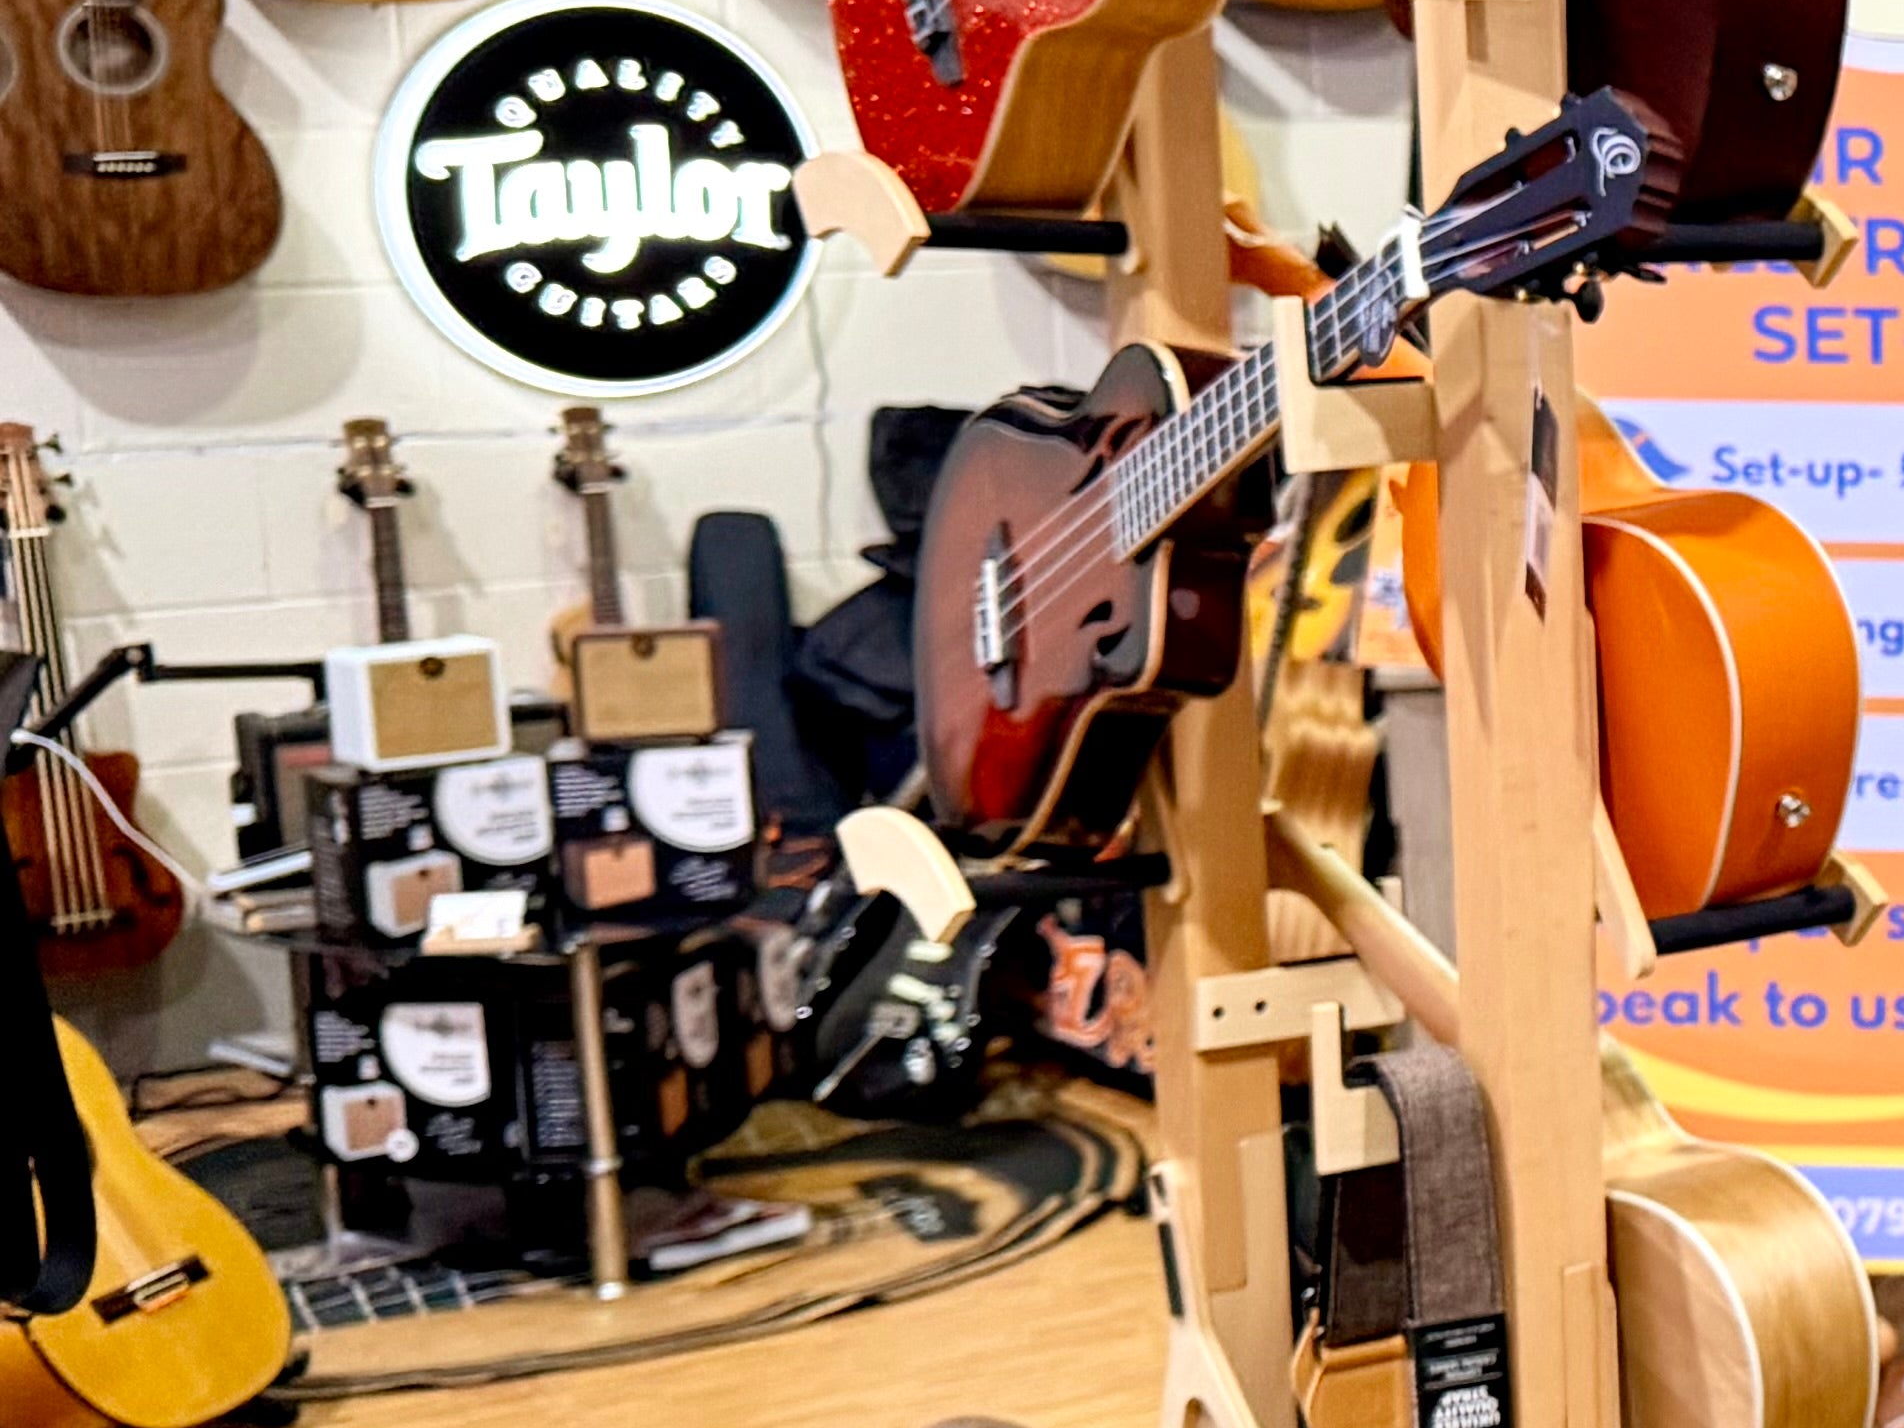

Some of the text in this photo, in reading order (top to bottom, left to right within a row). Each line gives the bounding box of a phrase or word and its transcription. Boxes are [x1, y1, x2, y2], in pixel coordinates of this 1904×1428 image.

[414, 123, 793, 274] Taylor
[1711, 444, 1884, 499] Set-up-
[1598, 969, 1743, 1027] eak
[1764, 981, 1829, 1029] to
